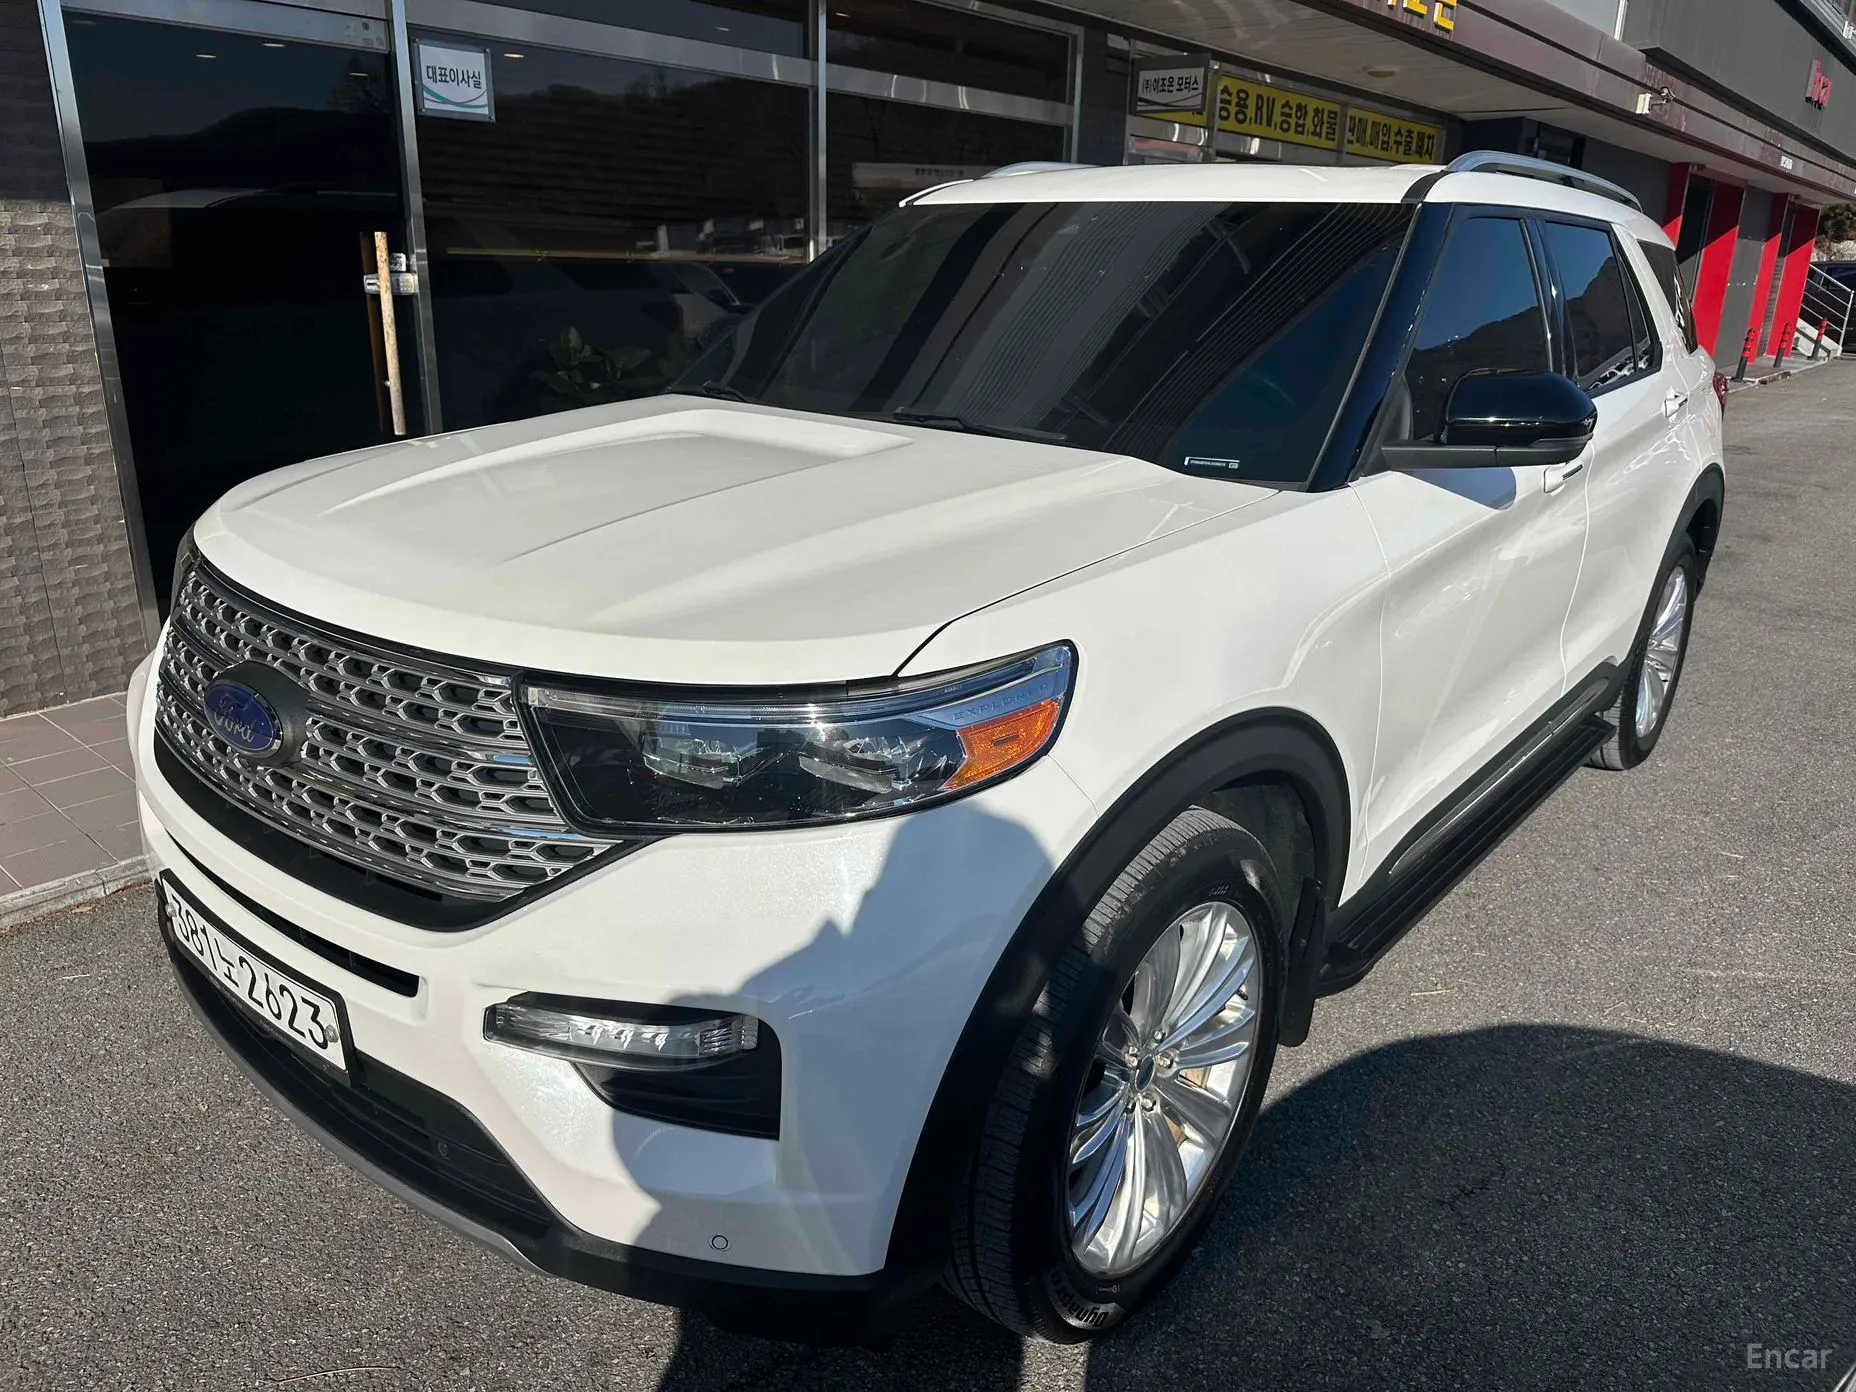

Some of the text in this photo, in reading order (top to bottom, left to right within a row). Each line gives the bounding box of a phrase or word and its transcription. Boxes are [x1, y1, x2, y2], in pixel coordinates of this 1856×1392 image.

[426, 65, 482, 90] 대표이사실
[1142, 75, 1200, 94] (주)이조은 모터스
[214, 692, 255, 743] Ford
[171, 893, 329, 1050] 381노2623
